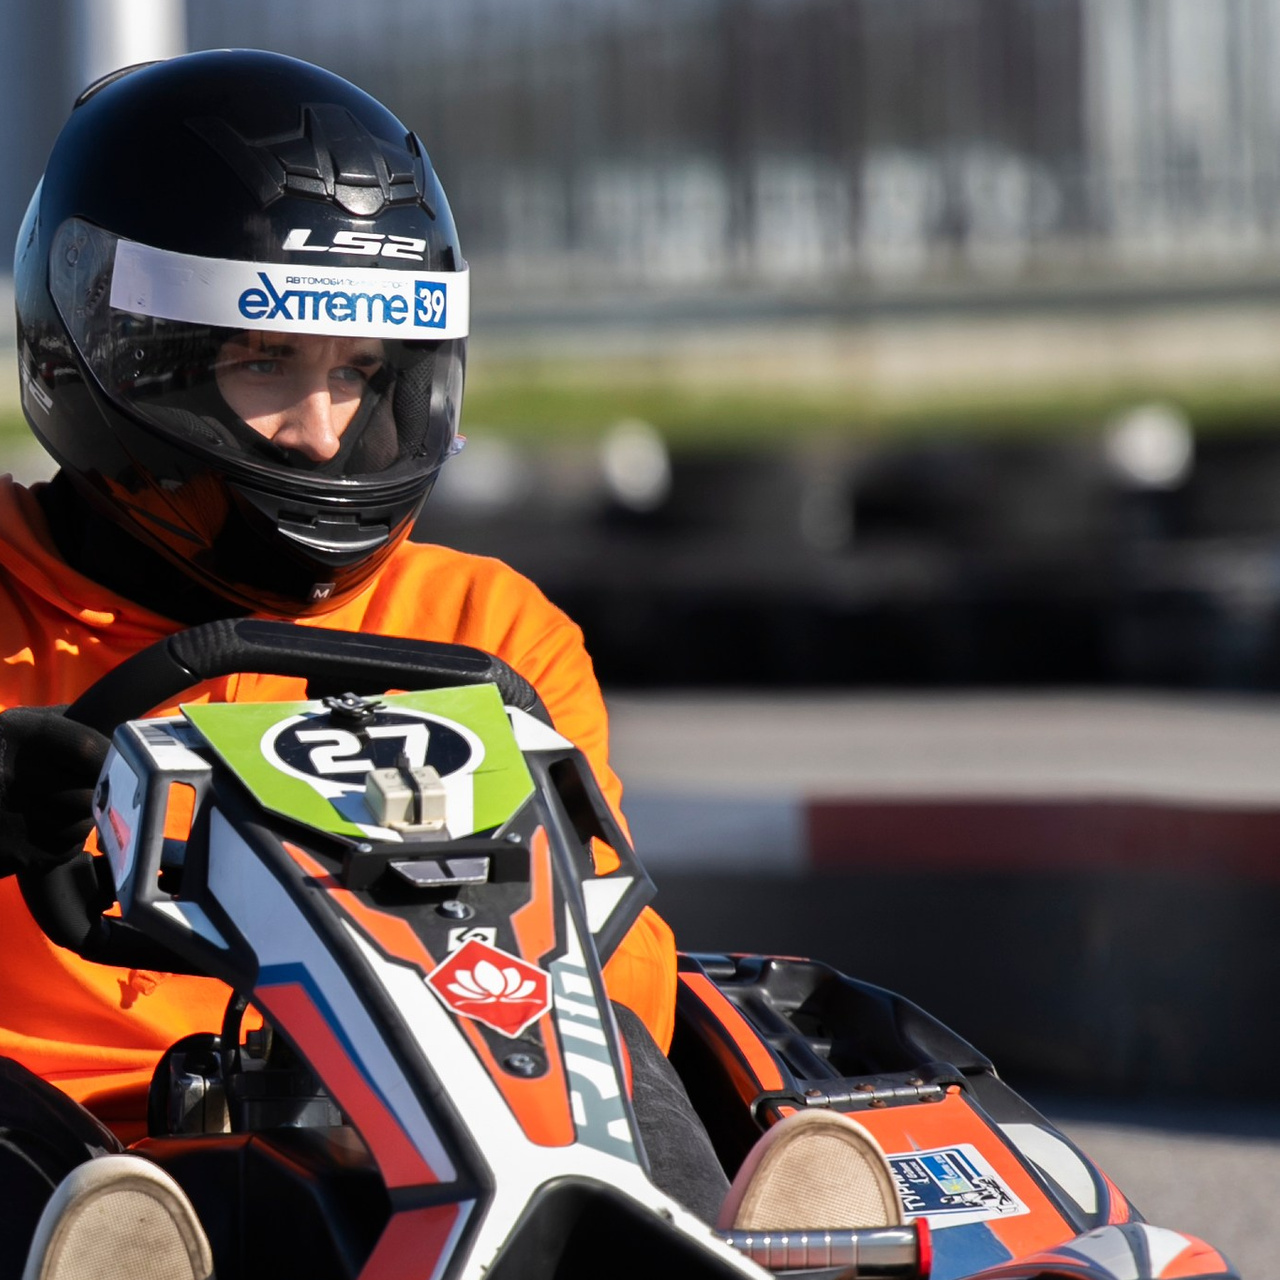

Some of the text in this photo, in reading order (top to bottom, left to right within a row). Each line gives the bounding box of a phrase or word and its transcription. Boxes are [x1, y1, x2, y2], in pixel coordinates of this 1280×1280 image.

[281, 228, 427, 261] LS2
[417, 287, 446, 324] 39
[312, 588, 331, 599] M
[294, 723, 431, 774] 27
